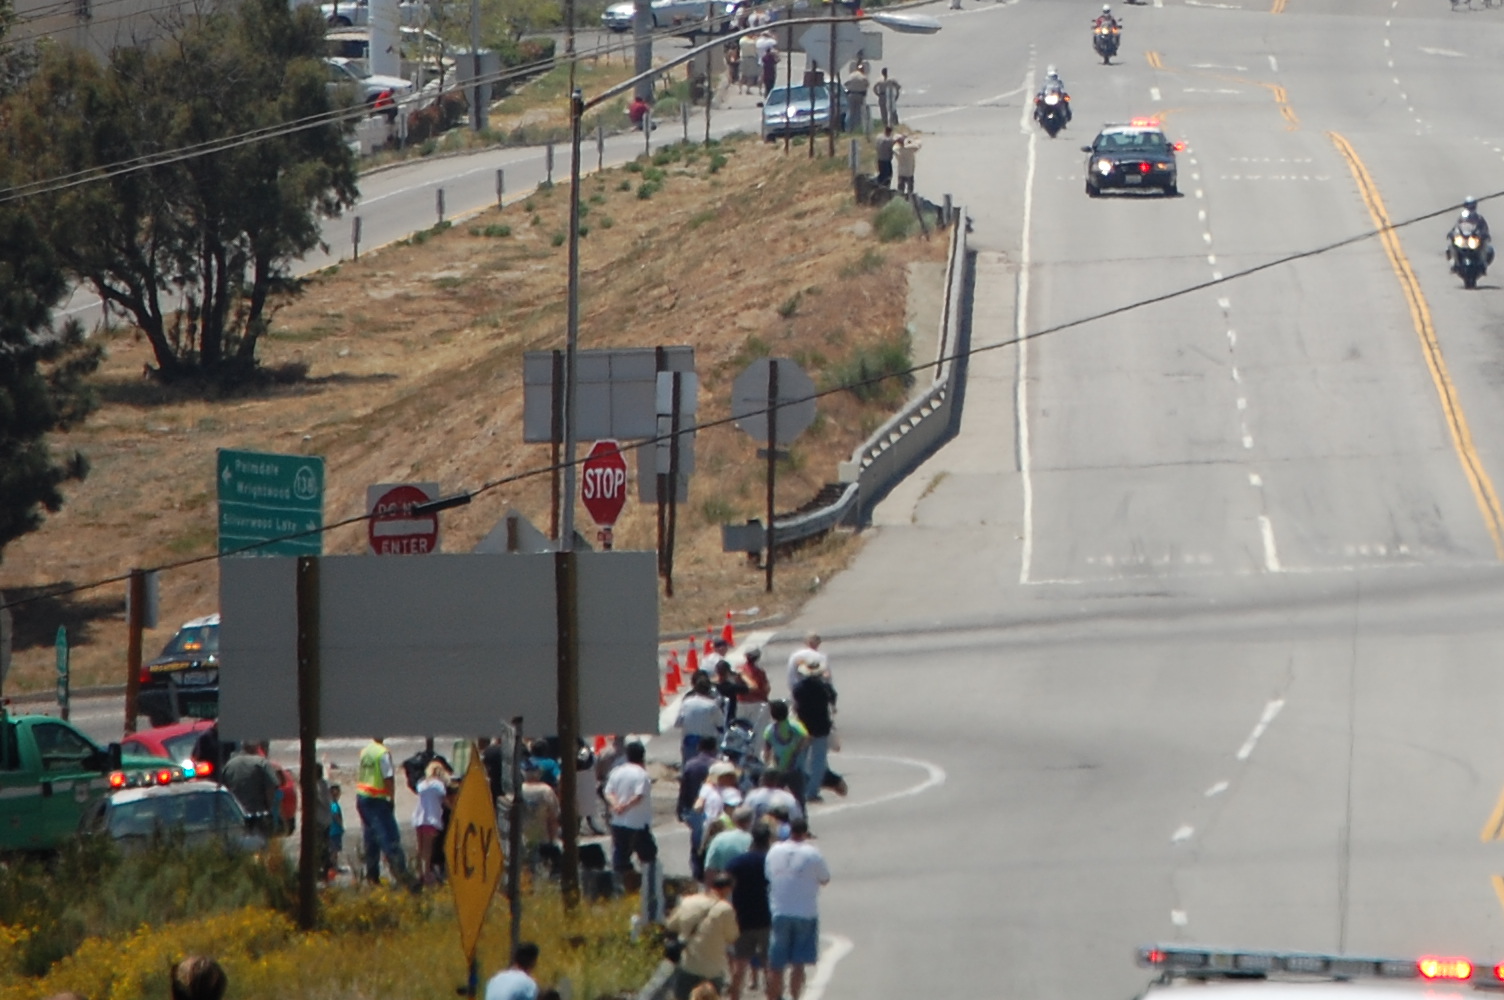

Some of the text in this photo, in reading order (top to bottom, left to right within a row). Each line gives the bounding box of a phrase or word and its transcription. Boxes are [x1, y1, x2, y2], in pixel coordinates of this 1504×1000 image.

[237, 481, 290, 499] Wrightwood
[297, 475, 317, 494] 138
[584, 467, 625, 499] STOP
[379, 502, 398, 517] DO
[223, 513, 297, 531] Silverwood Lake
[381, 538, 428, 556] ENTER
[453, 820, 493, 883] ICY
